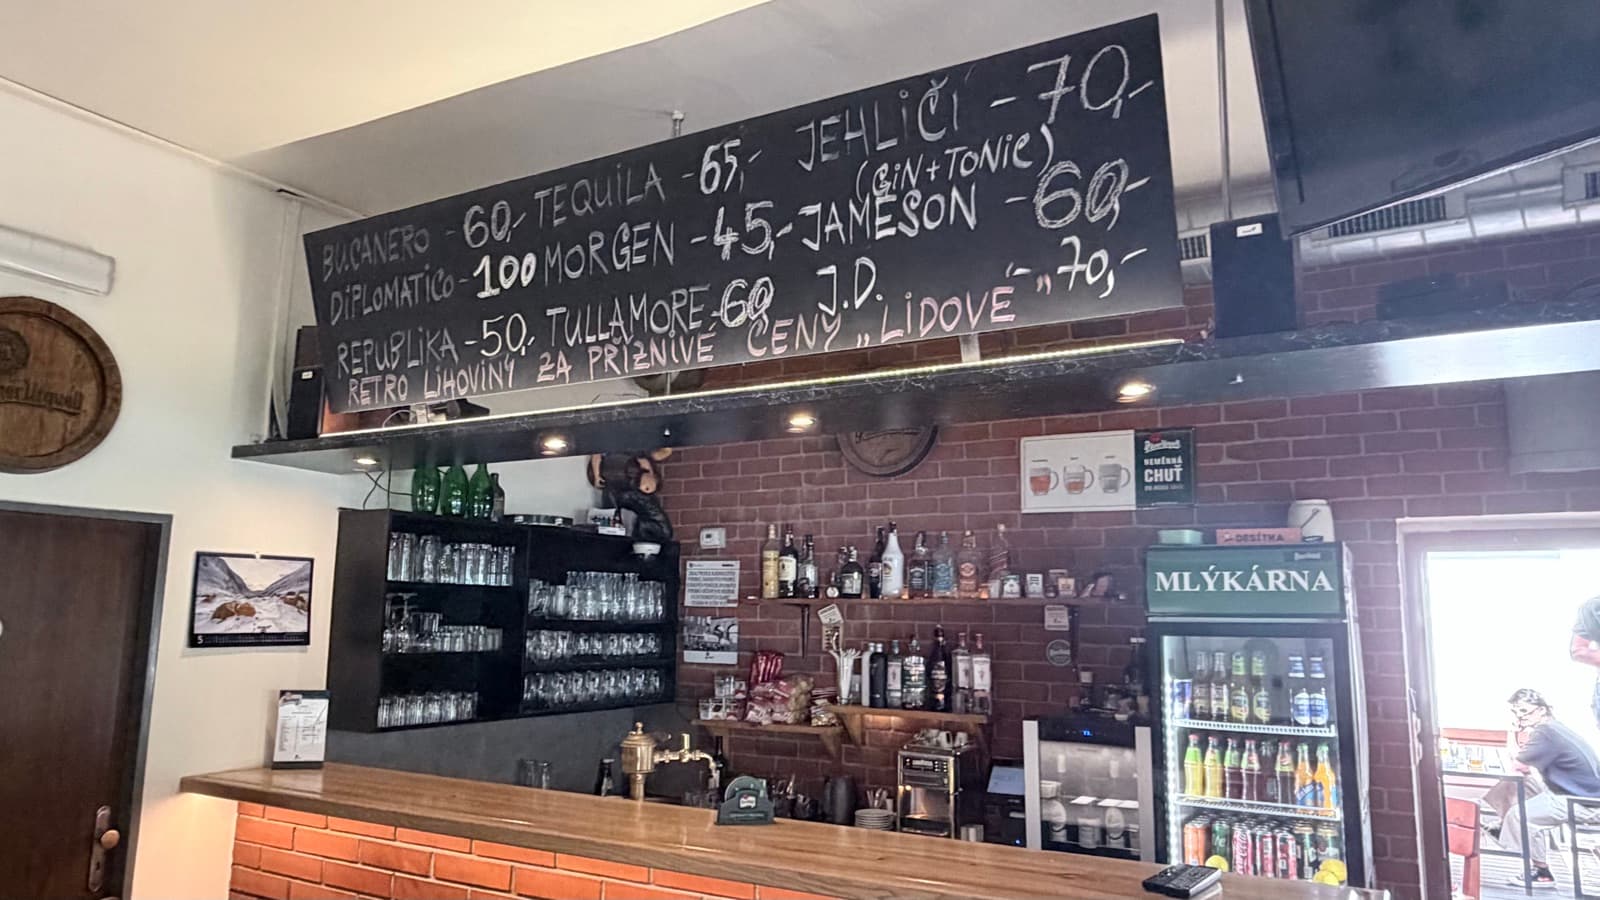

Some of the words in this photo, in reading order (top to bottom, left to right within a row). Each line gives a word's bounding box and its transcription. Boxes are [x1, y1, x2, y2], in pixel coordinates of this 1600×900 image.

[534, 162, 665, 228] TEQUILA
[330, 263, 454, 326] DIPLOMATICO
[544, 220, 675, 288] MORGEN
[798, 182, 977, 251] JAMESON
[337, 326, 459, 379] REPUBLIKA
[546, 284, 710, 347] TULLAMORE
[816, 256, 883, 316] J.D.
[348, 374, 408, 407] RETRO
[1144, 464, 1183, 482] CHUŤ
[1155, 564, 1335, 592] MLÝKÁRNA
